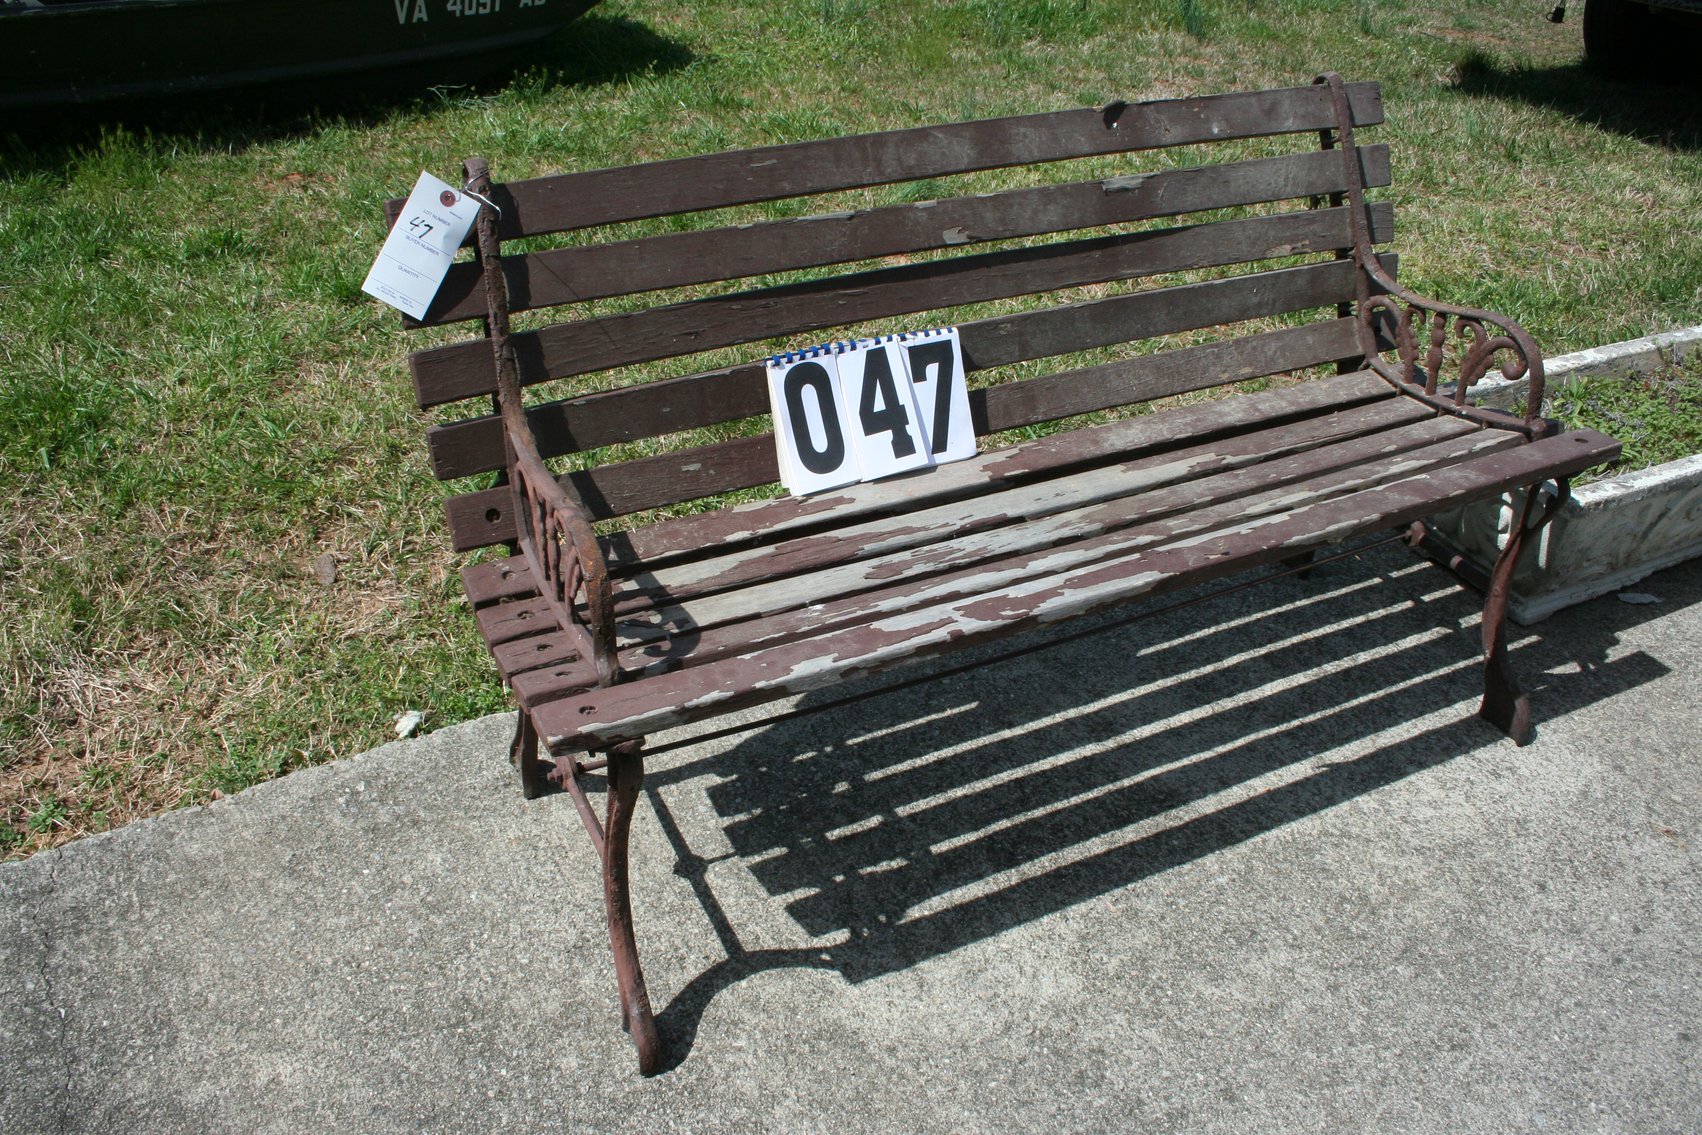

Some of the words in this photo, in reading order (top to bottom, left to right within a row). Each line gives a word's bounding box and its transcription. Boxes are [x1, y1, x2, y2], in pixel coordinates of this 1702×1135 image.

[395, 0, 428, 24] VA
[410, 216, 434, 239] 47
[785, 339, 954, 474] 047
